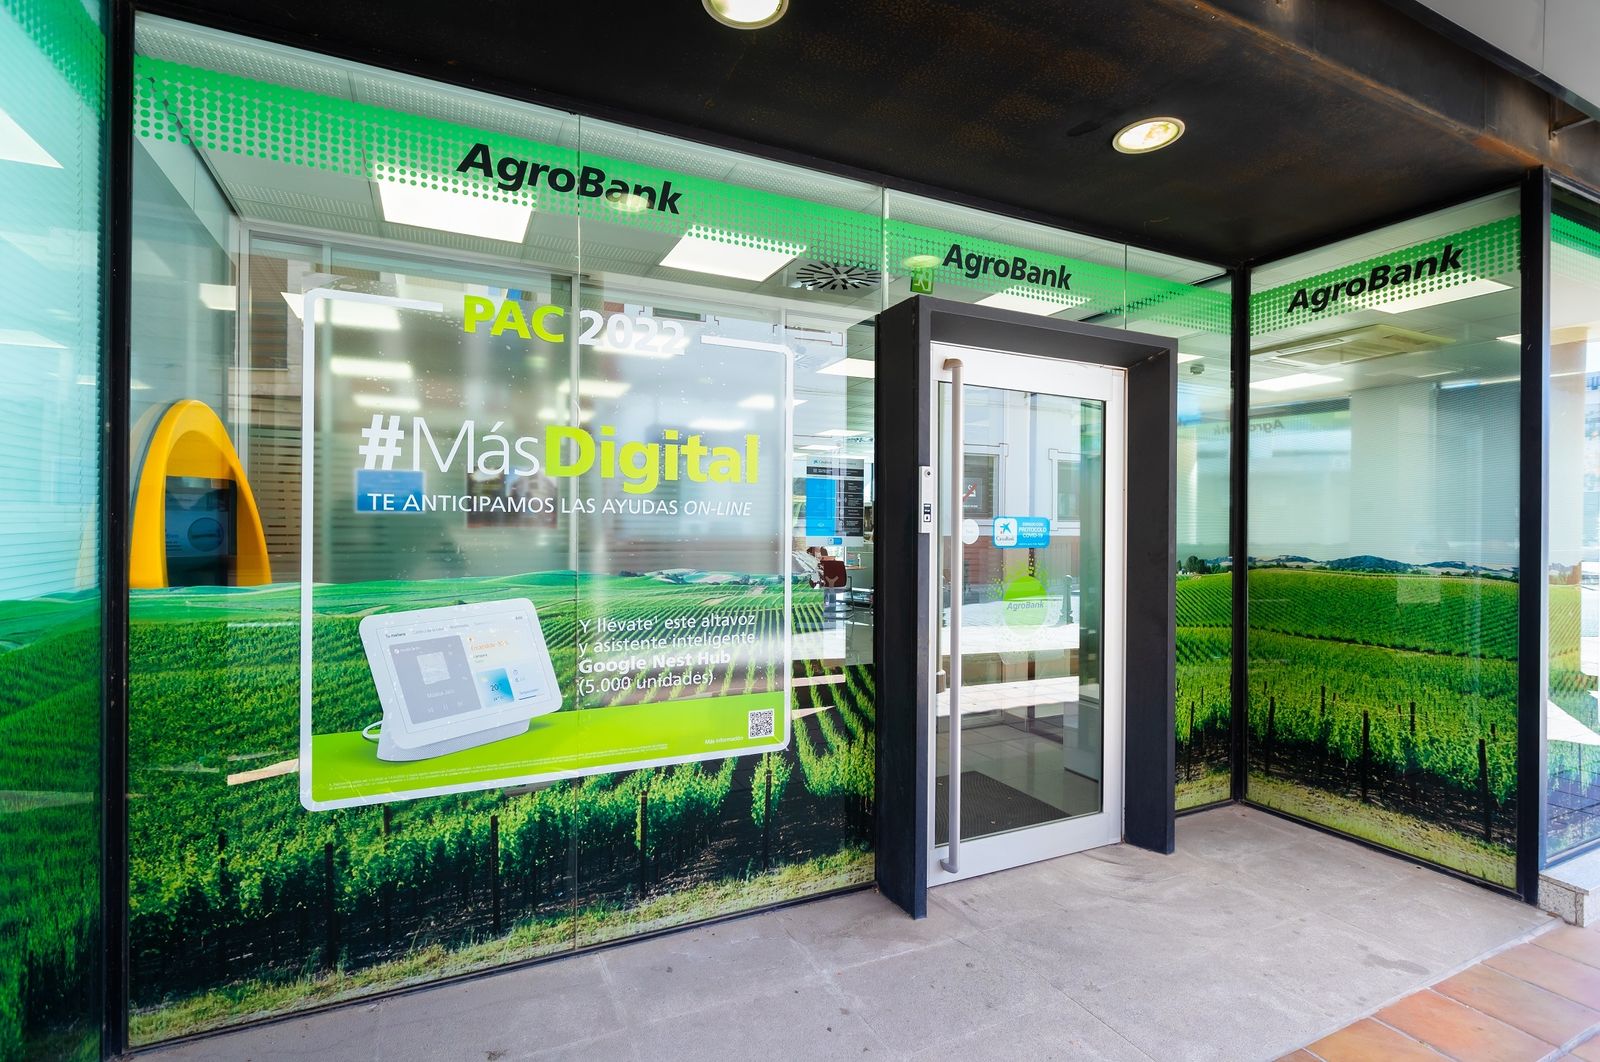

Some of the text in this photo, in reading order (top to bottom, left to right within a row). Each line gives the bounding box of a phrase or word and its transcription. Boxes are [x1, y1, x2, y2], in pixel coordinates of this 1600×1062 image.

[456, 143, 682, 215] AgroBank
[942, 243, 1072, 291] AgroBank
[1286, 243, 1465, 313] AgroBank
[463, 295, 685, 356] PAC 2022
[358, 414, 760, 494] #MásDigital
[367, 493, 752, 516] TE ANTICIPAMOS LAS AYUDAS ON-LINE
[1006, 600, 1044, 611] AgroBank
[578, 619, 592, 634] Y
[664, 617, 697, 630] este
[701, 613, 756, 628] altavoz
[578, 631, 755, 658] y asistente inteligente
[578, 650, 731, 674] Google Nest Hub
[578, 670, 714, 697] (5.000 unidades)
